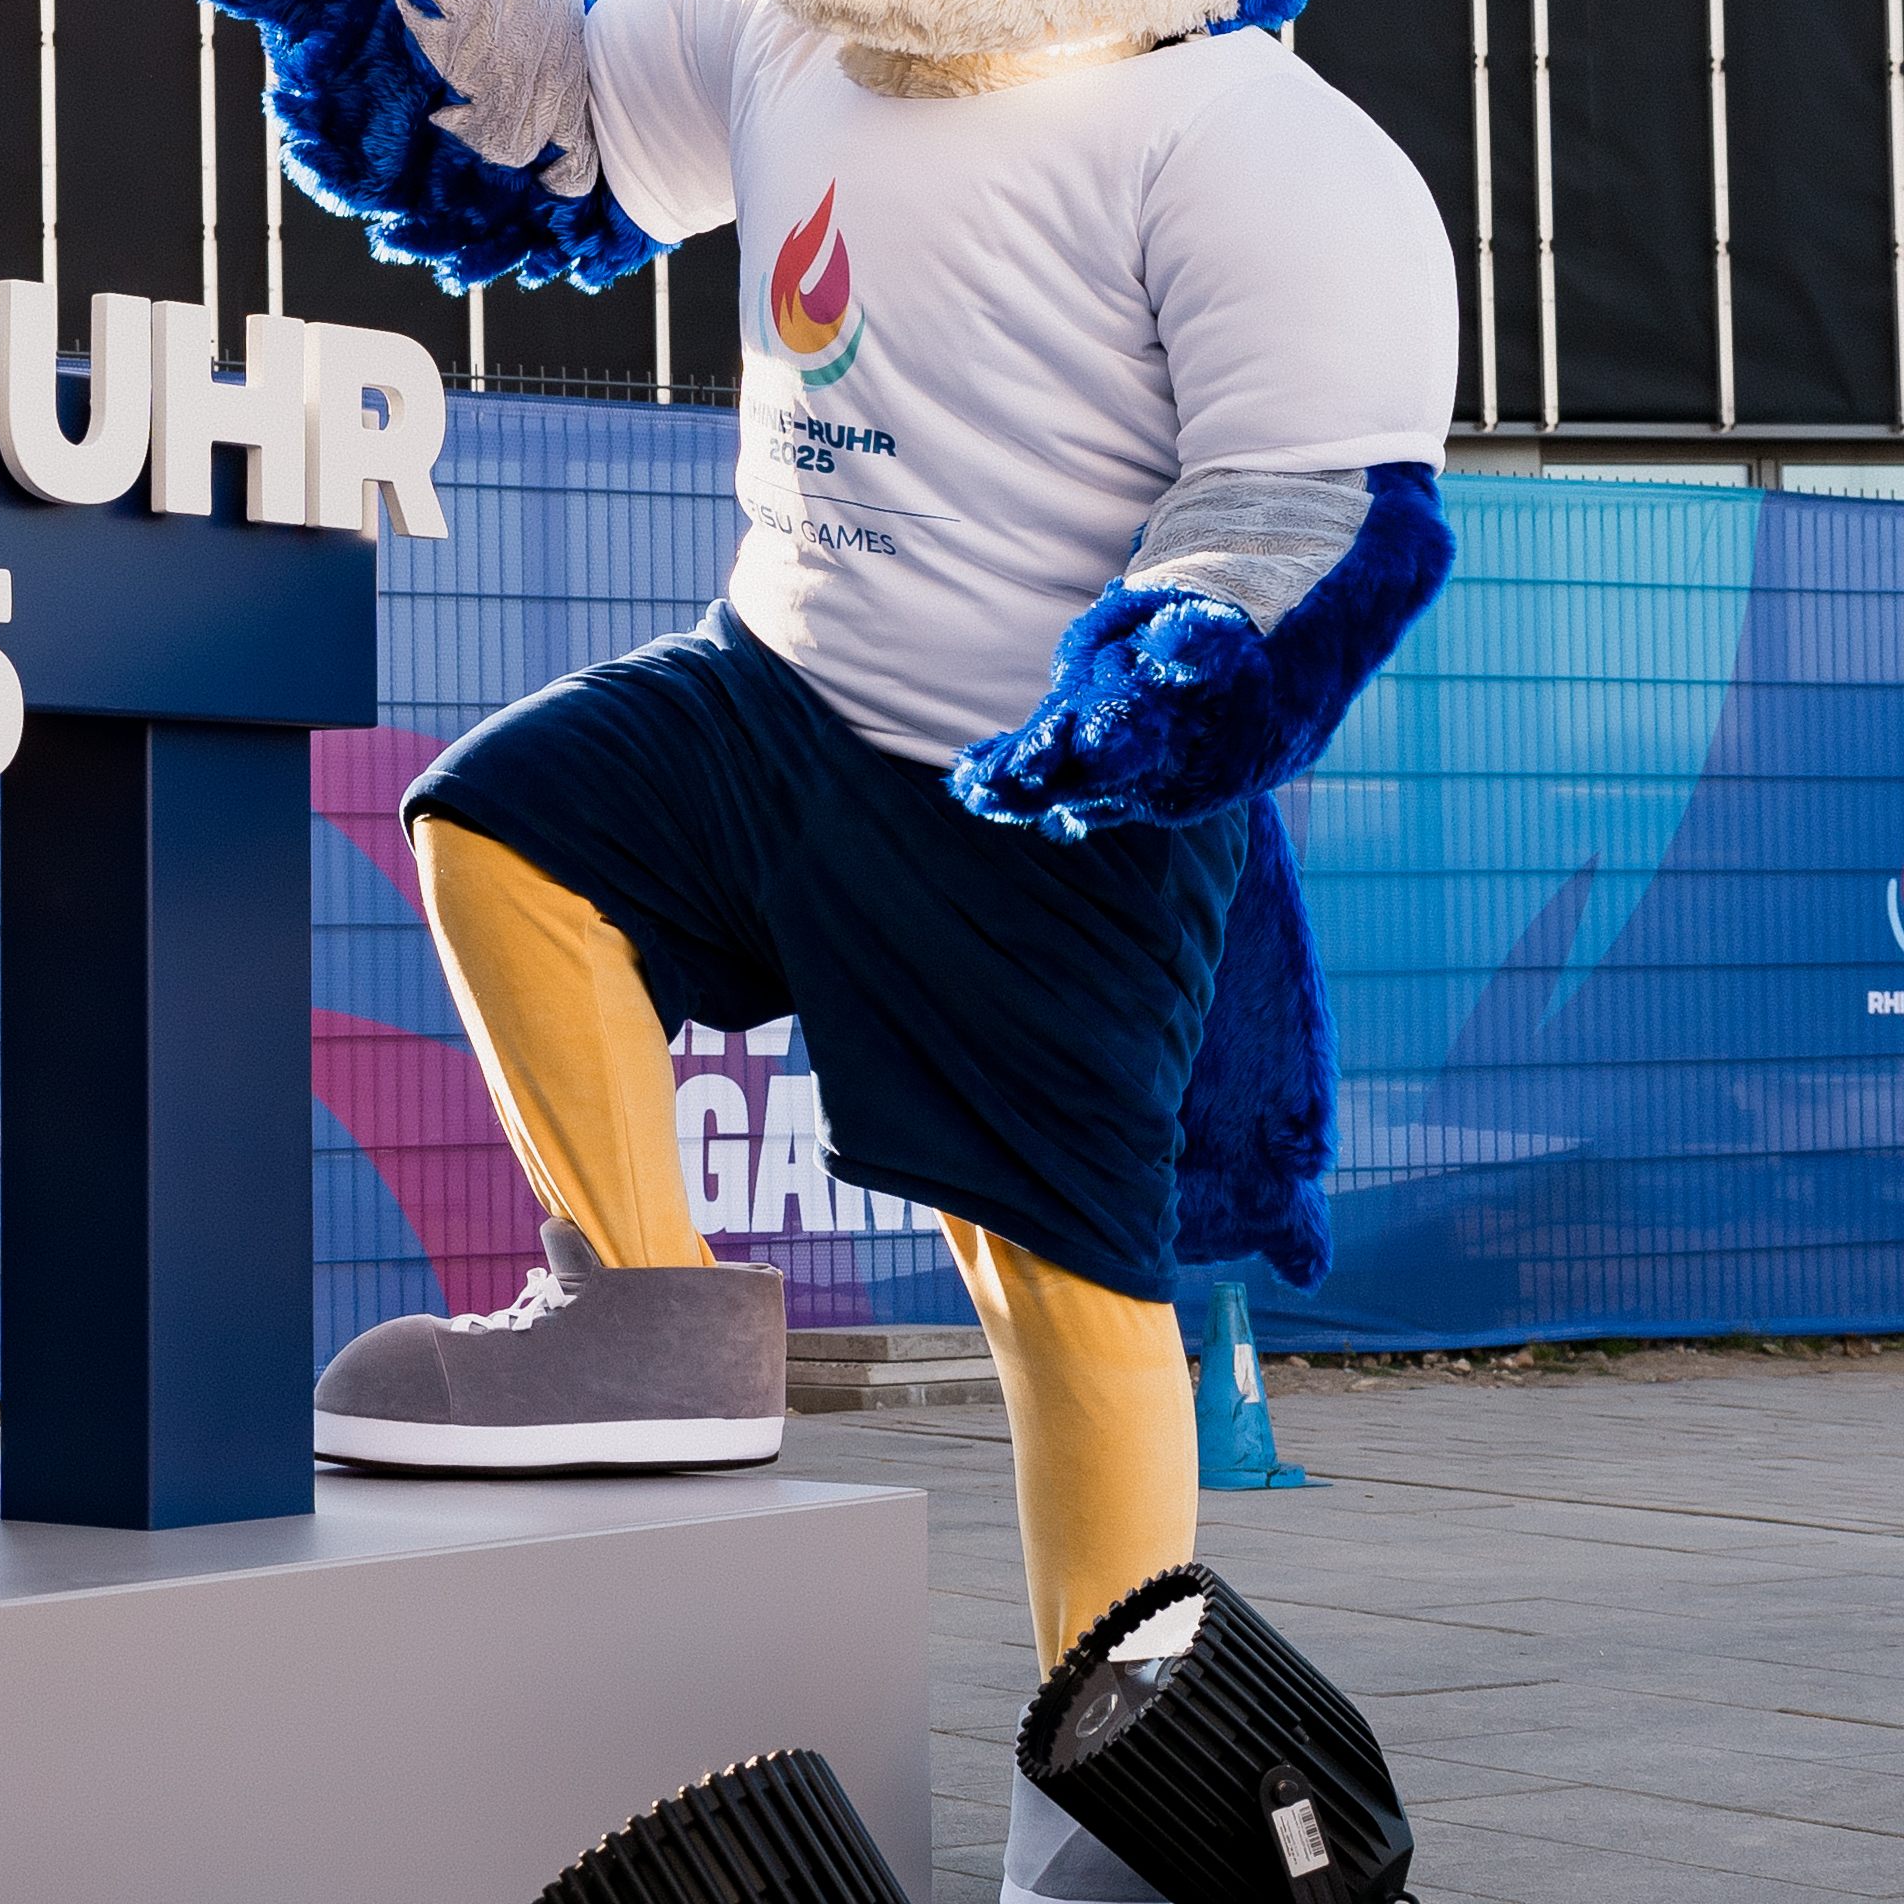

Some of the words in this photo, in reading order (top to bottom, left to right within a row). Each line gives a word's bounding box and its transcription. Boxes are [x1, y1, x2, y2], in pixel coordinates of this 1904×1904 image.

[751, 399, 896, 457] HINE-RUHR
[770, 437, 835, 474] 2025
[801, 520, 897, 555] GAMES
